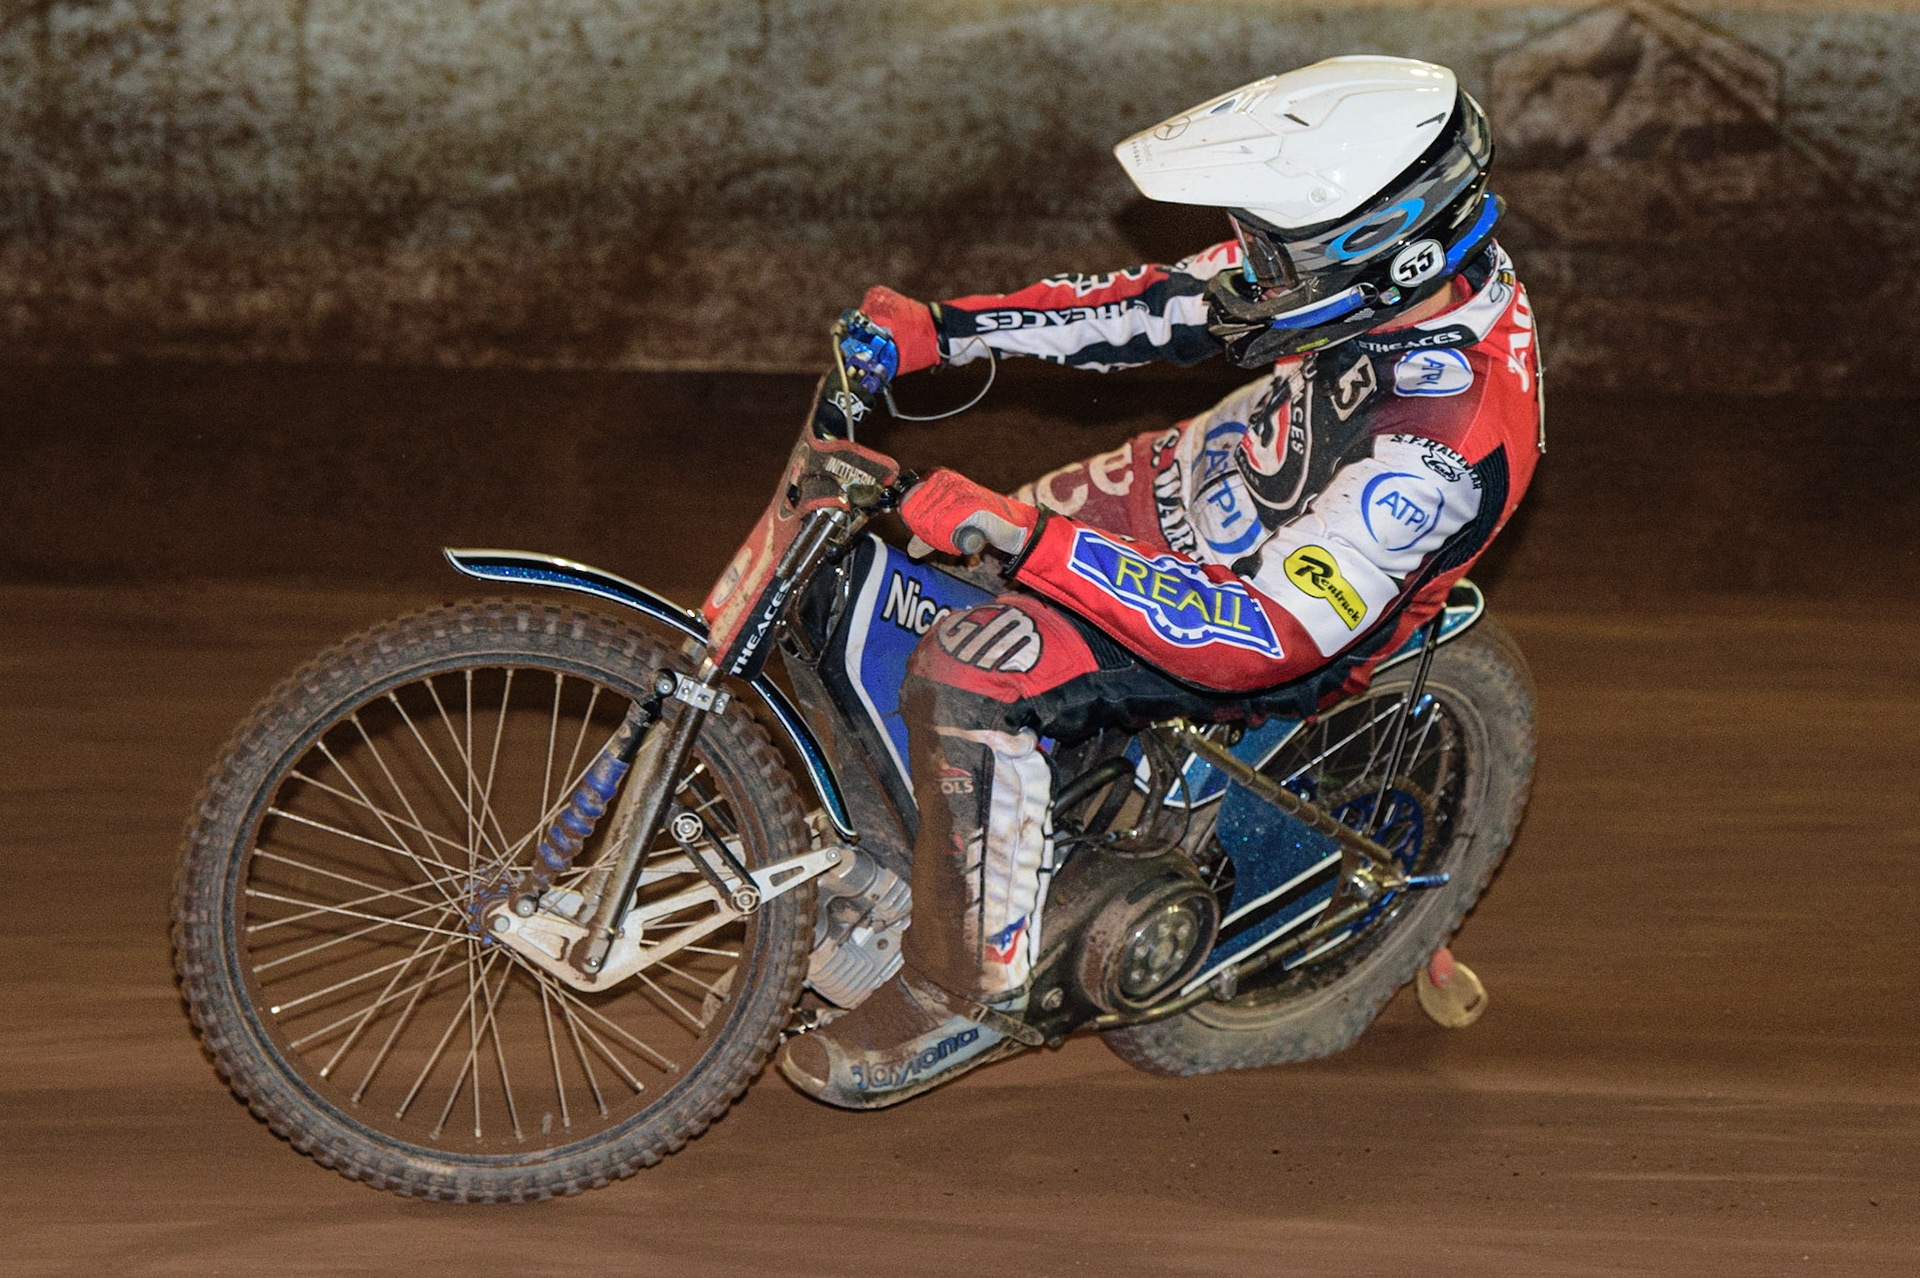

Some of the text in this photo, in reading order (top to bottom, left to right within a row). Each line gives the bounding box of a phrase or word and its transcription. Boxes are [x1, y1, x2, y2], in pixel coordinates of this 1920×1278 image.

[1375, 490, 1430, 533] ATPI
[1115, 556, 1252, 632] REALL
[1294, 554, 1360, 622] Rentruck
